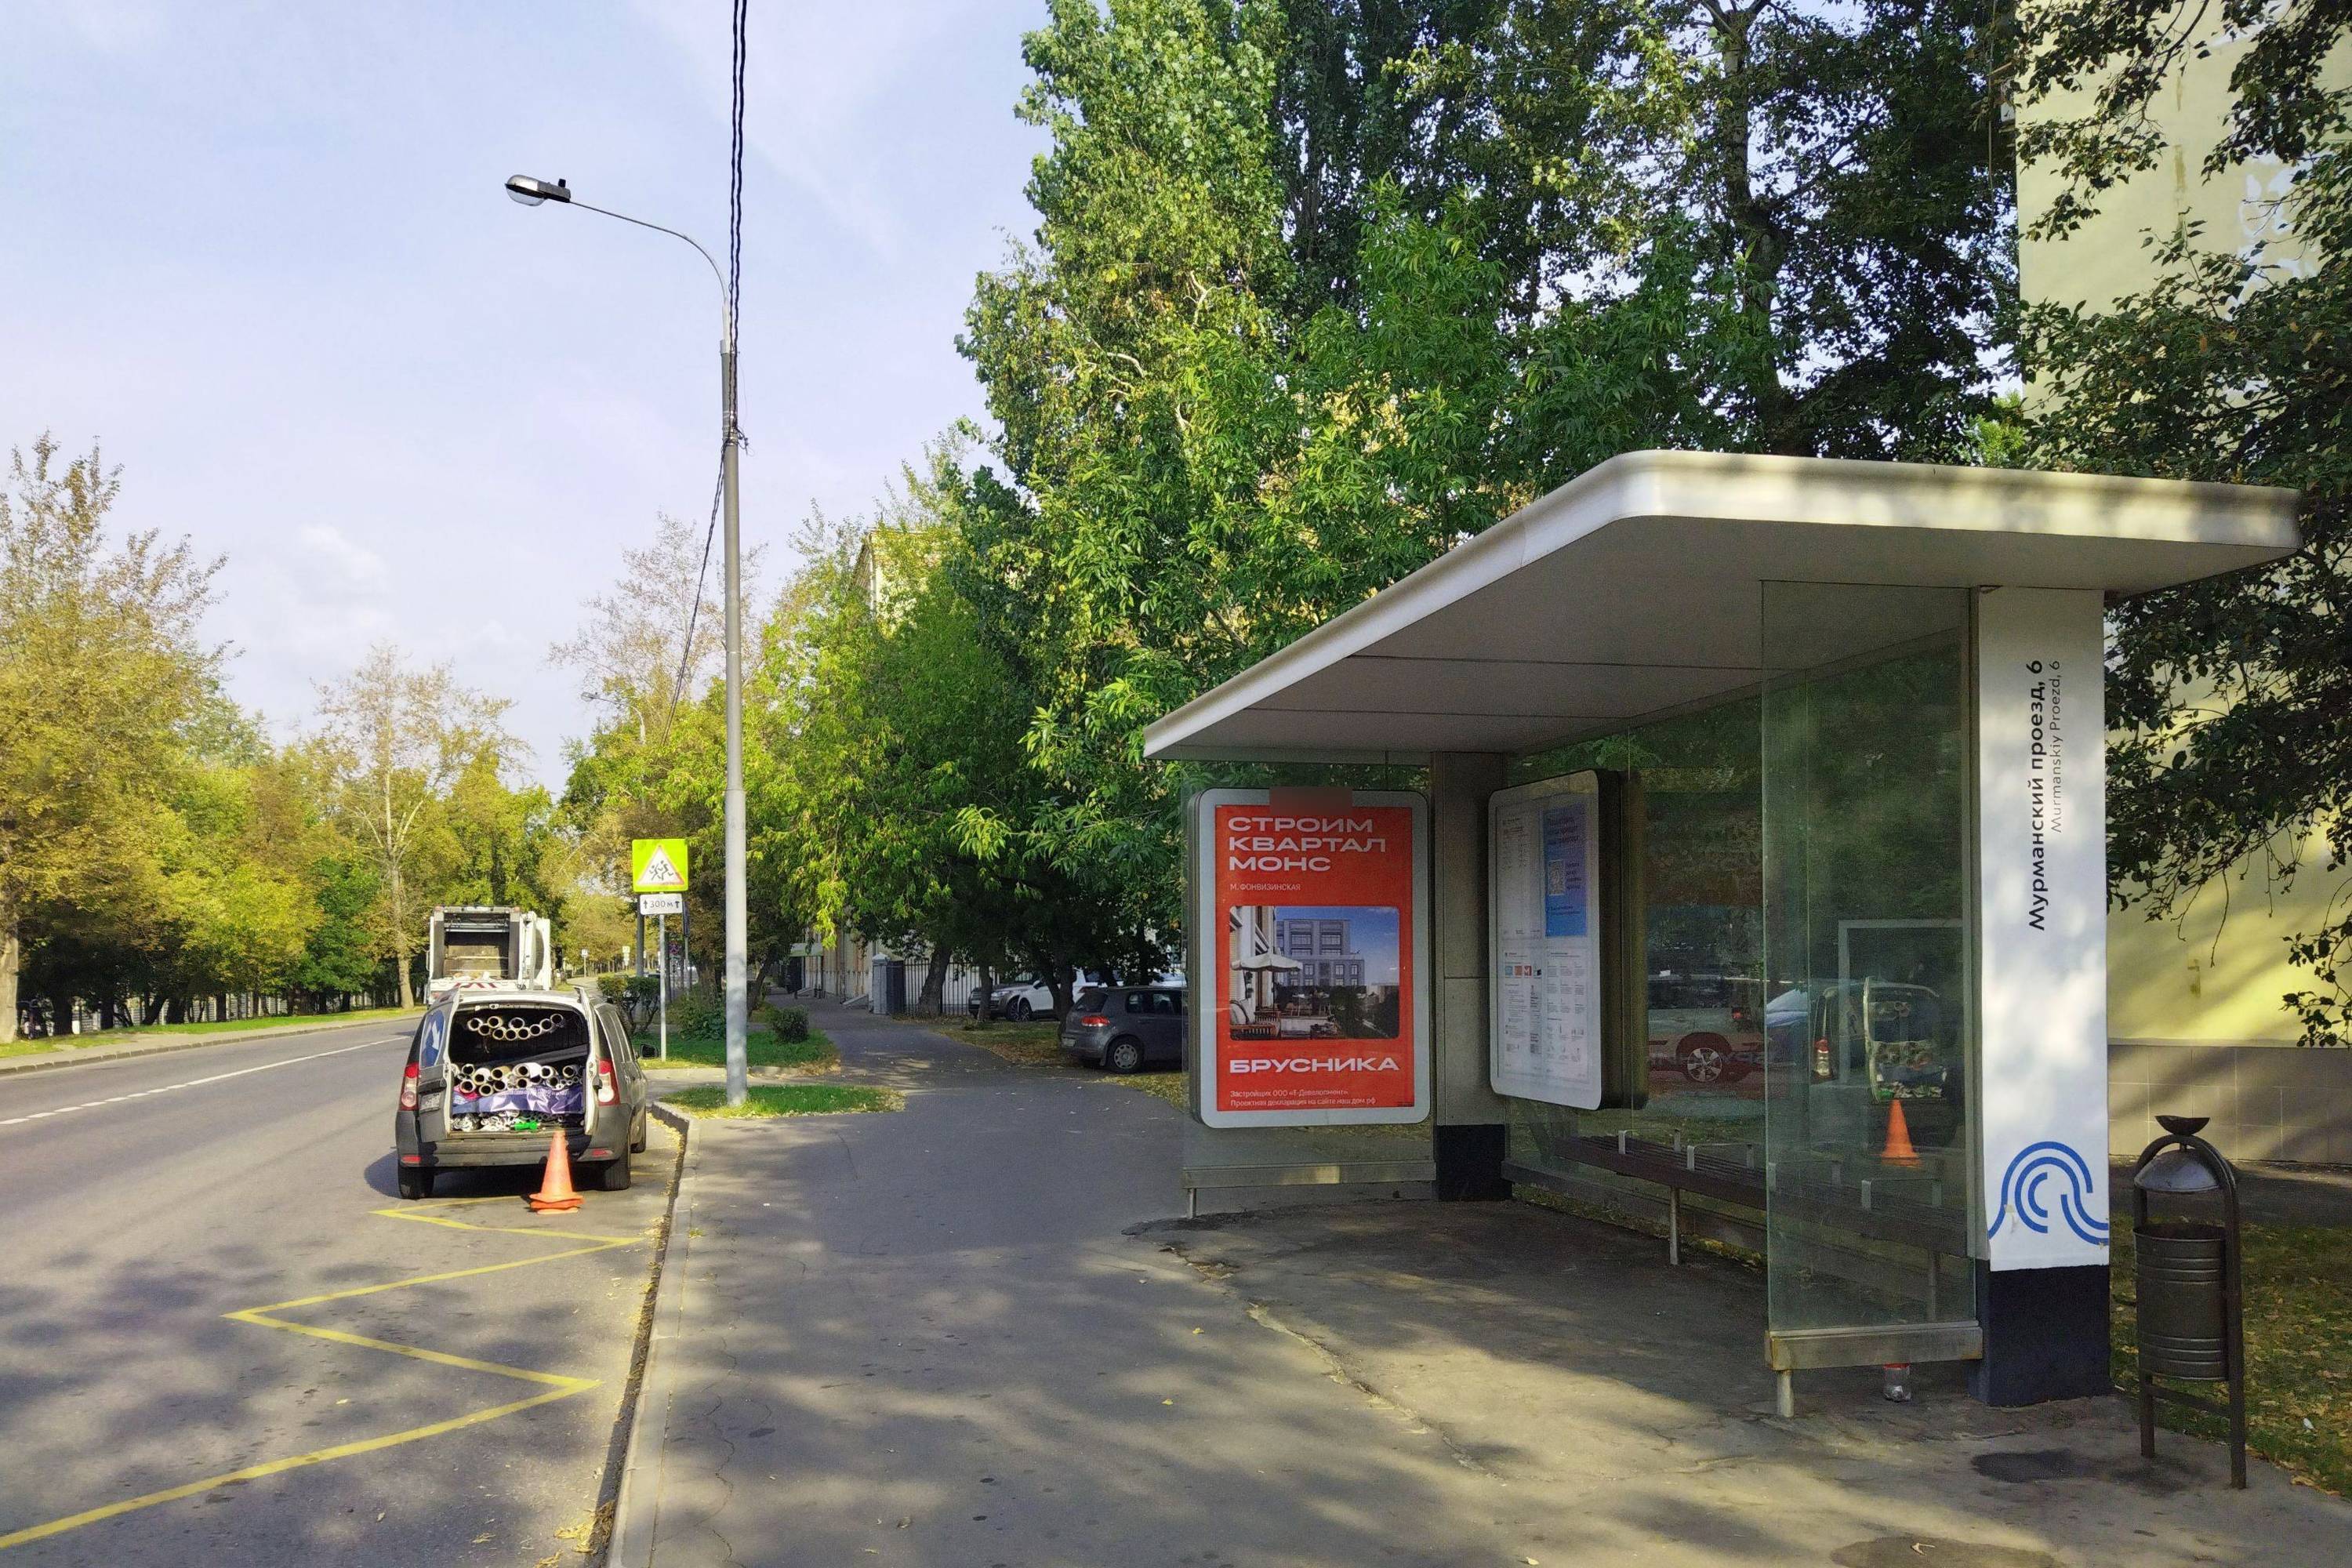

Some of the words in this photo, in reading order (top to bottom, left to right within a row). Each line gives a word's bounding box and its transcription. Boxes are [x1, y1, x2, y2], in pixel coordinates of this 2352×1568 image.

[2025, 660, 2043, 674] 6
[2049, 660, 2060, 670] 6
[2049, 674, 2062, 731] Proezd,
[2031, 681, 2047, 770] проезд,
[2049, 735, 2063, 833] Murmanskiy
[1228, 816, 1373, 833] СТРОИМ
[1229, 836, 1386, 853] КВАРТАЛ
[2027, 777, 2049, 931] Мурманский
[1229, 855, 1331, 871] МОНС
[1240, 883, 1301, 891] ФОНВИЗИНСКАЯ
[1229, 1057, 1399, 1074] БРУСНИКА
